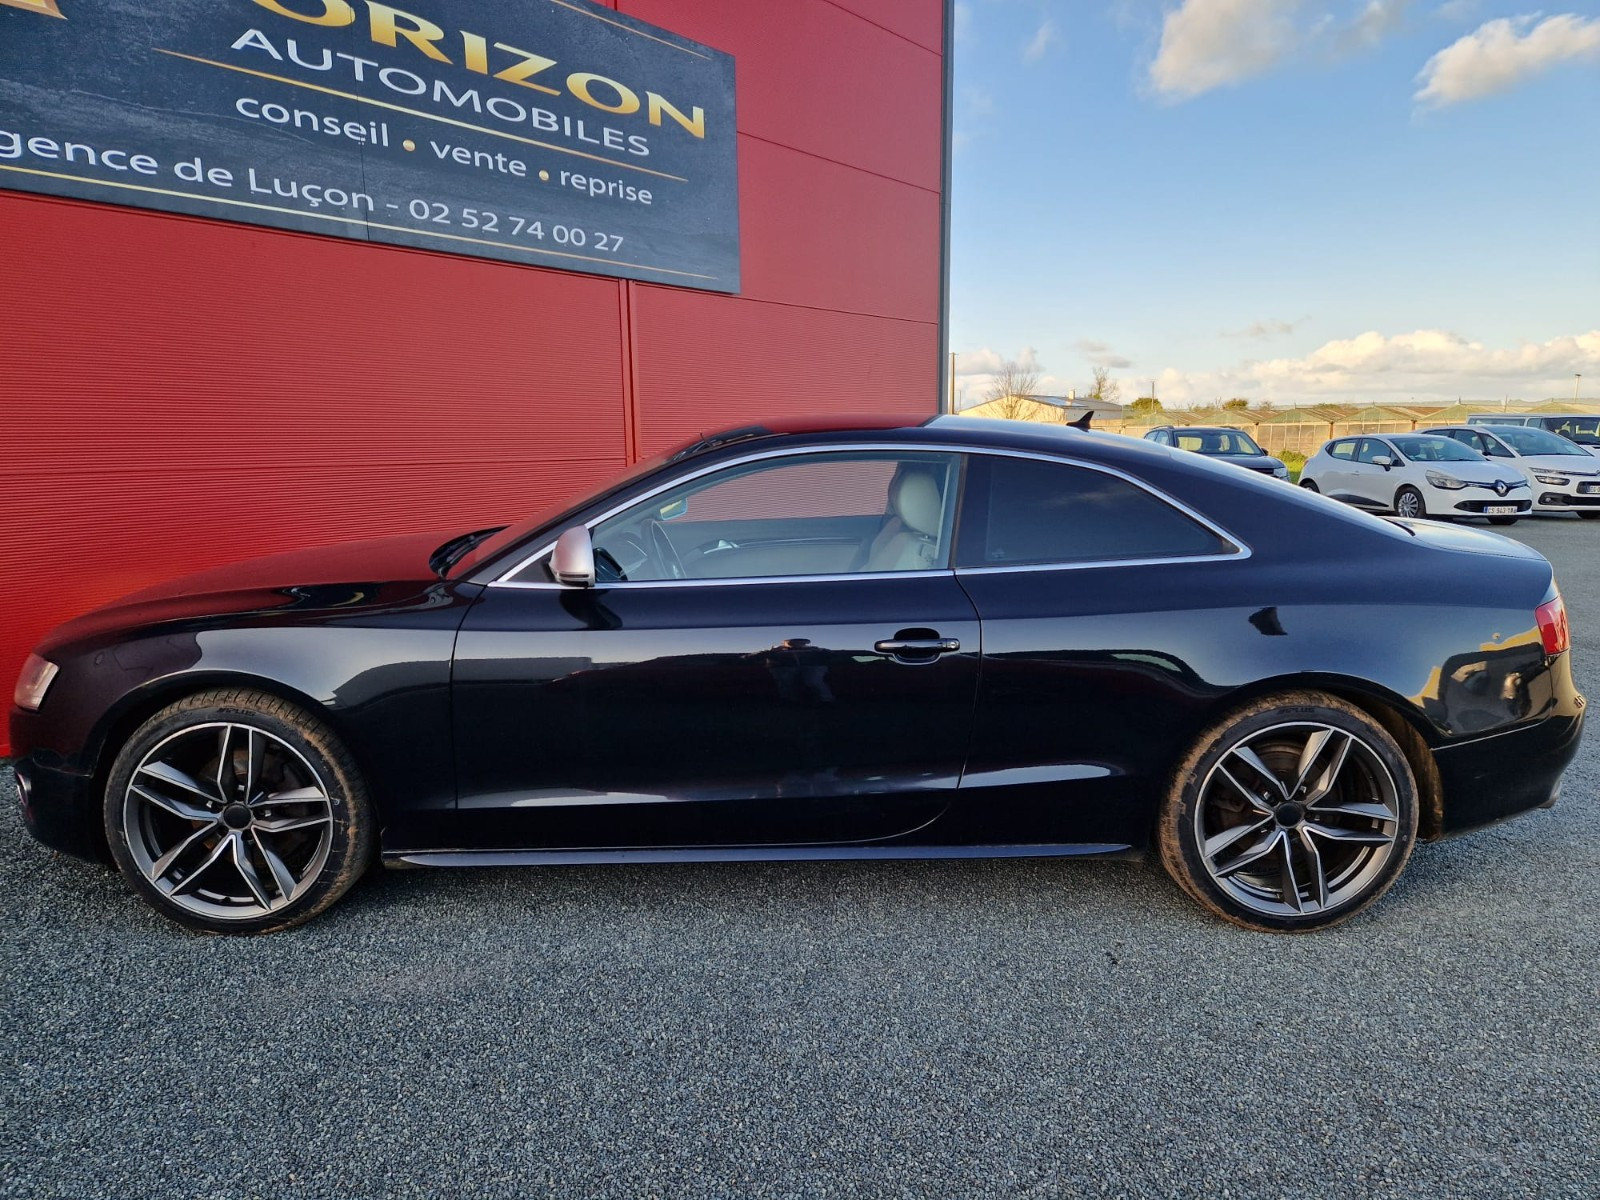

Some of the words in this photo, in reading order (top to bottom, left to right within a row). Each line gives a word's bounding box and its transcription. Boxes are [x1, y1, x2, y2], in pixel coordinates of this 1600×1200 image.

[231, 28, 650, 156] AUTOMOBILES
[173, 157, 234, 187] de
[249, 168, 374, 212] Luçon
[409, 199, 451, 224] 02
[461, 209, 499, 233] 52
[508, 216, 545, 240] 74
[552, 224, 586, 247] 00
[594, 232, 624, 252] 27
[235, 98, 389, 147] conseil
[430, 140, 527, 177] vente
[560, 169, 653, 205] reprise
